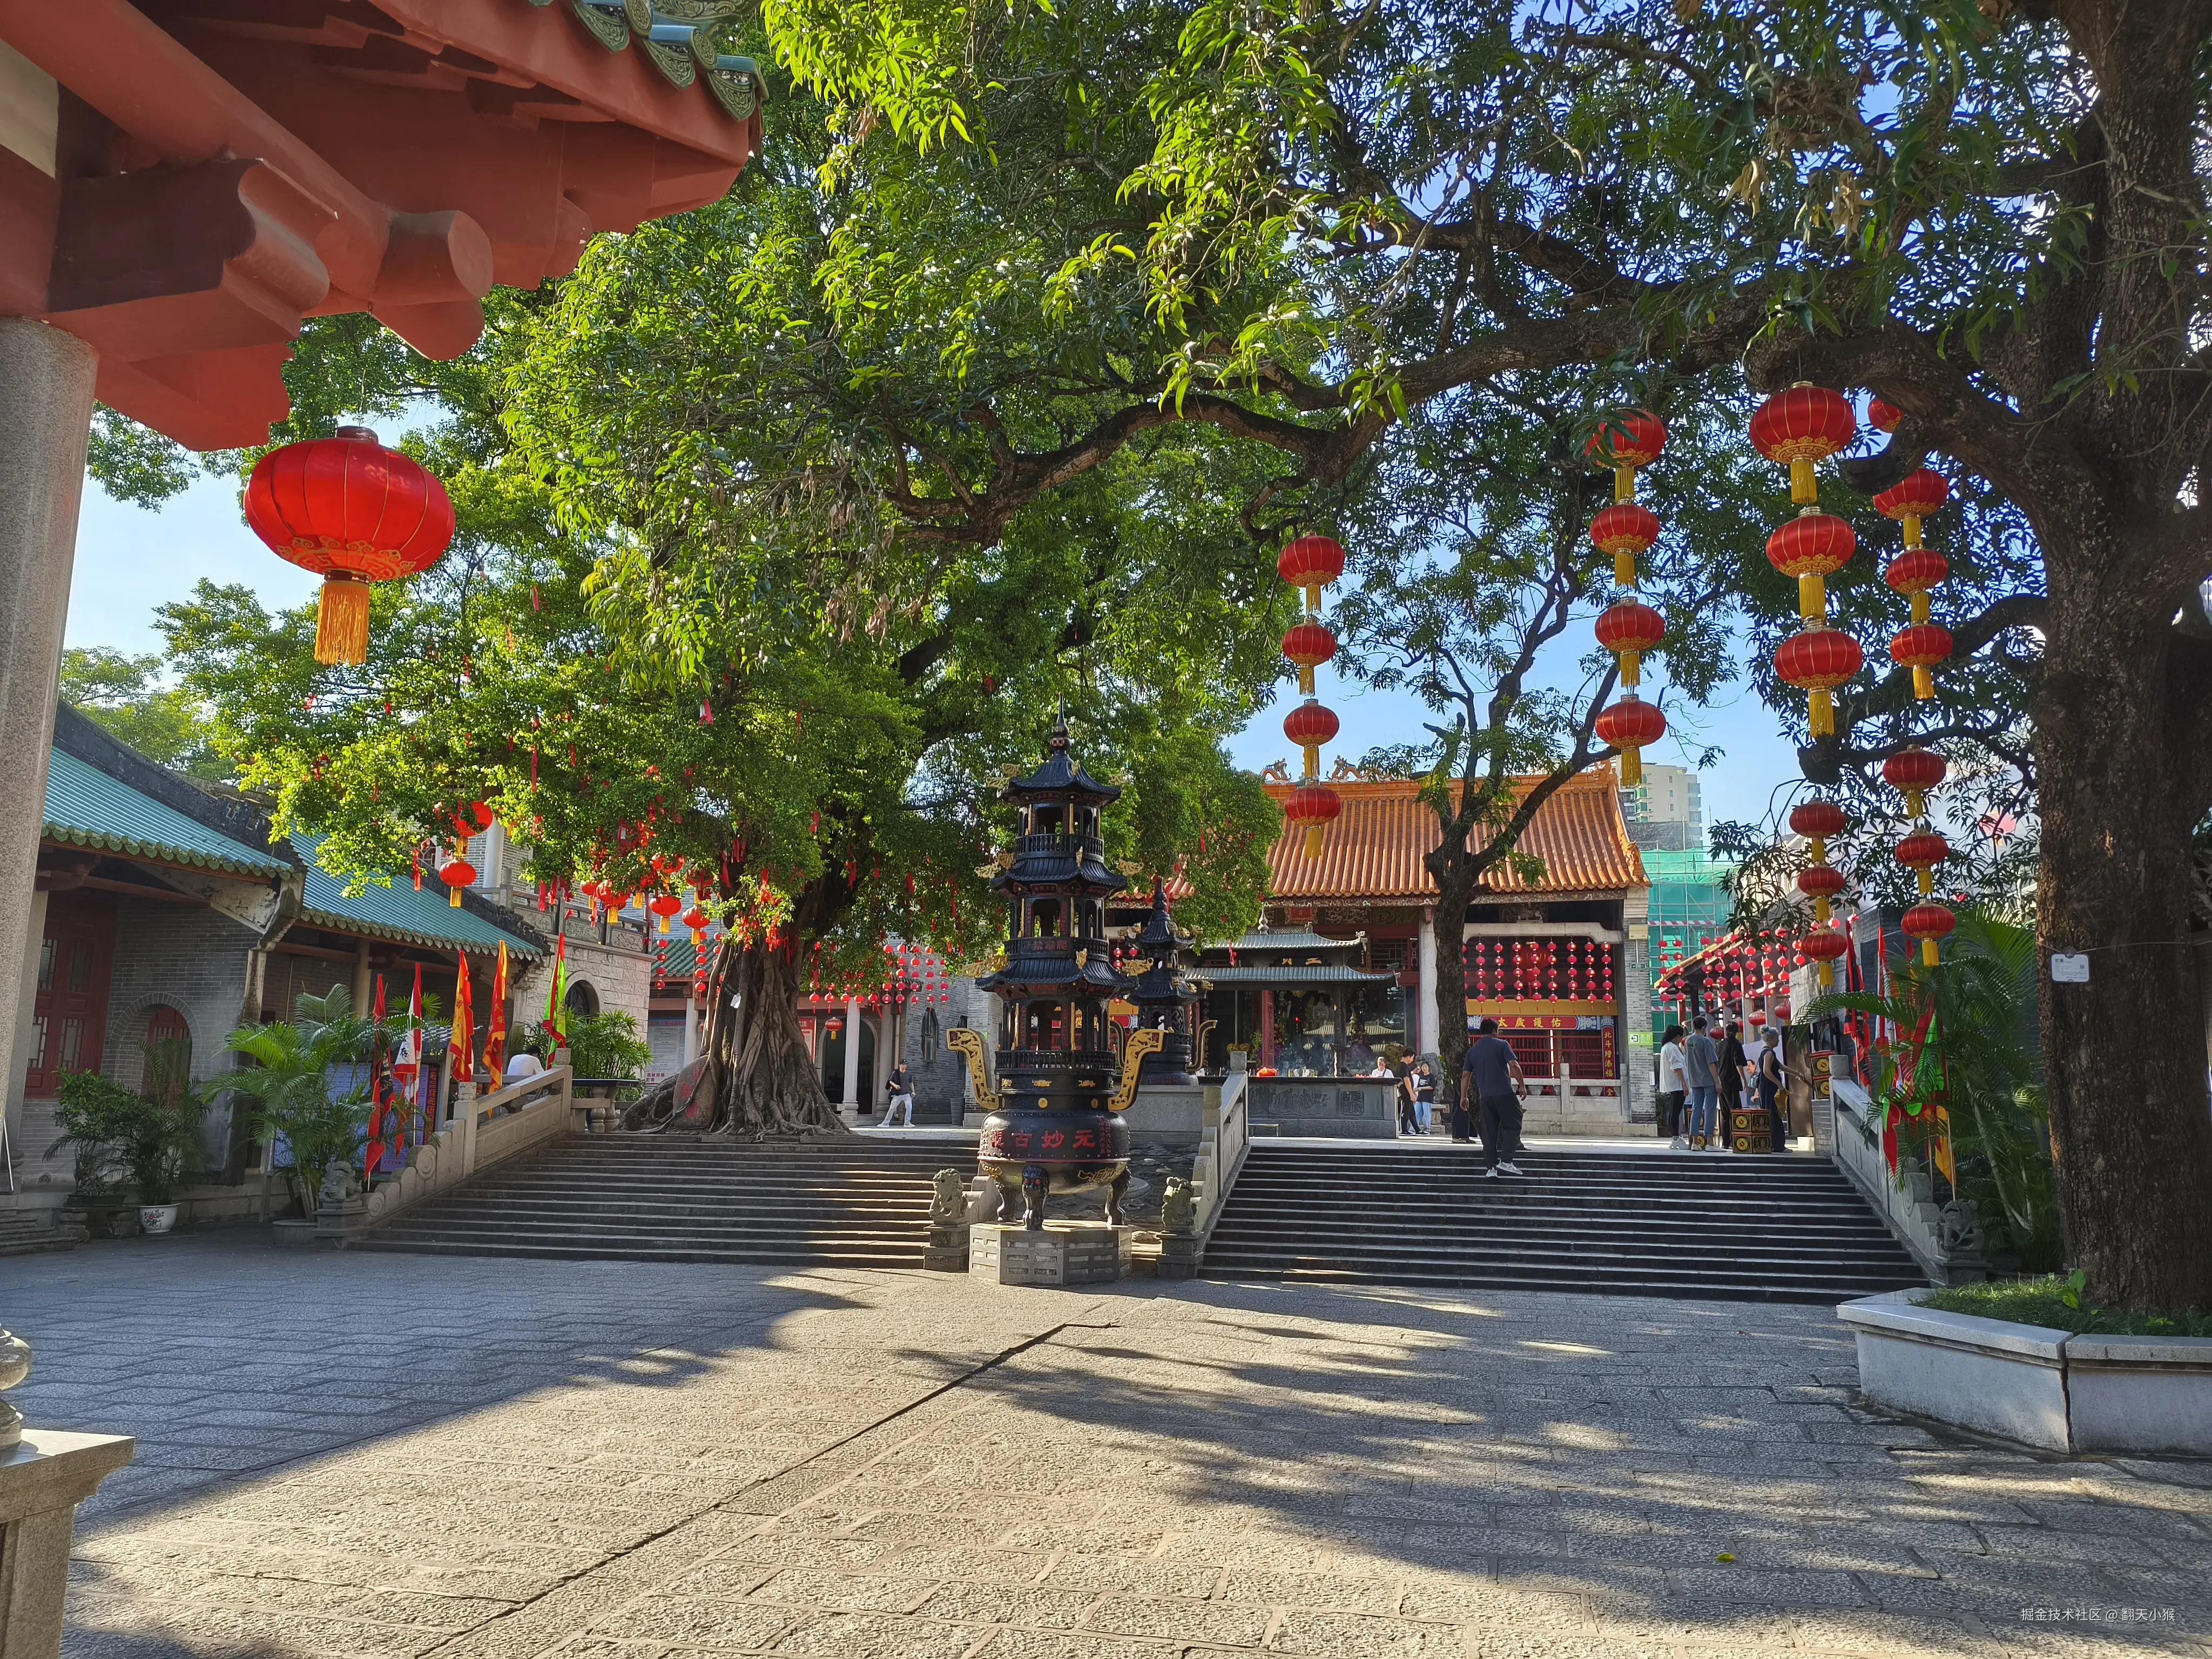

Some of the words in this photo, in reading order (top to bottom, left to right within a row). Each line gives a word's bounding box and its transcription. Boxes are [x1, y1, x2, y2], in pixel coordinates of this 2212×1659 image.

[1604, 1031, 1614, 1096] 北斗增添福全
